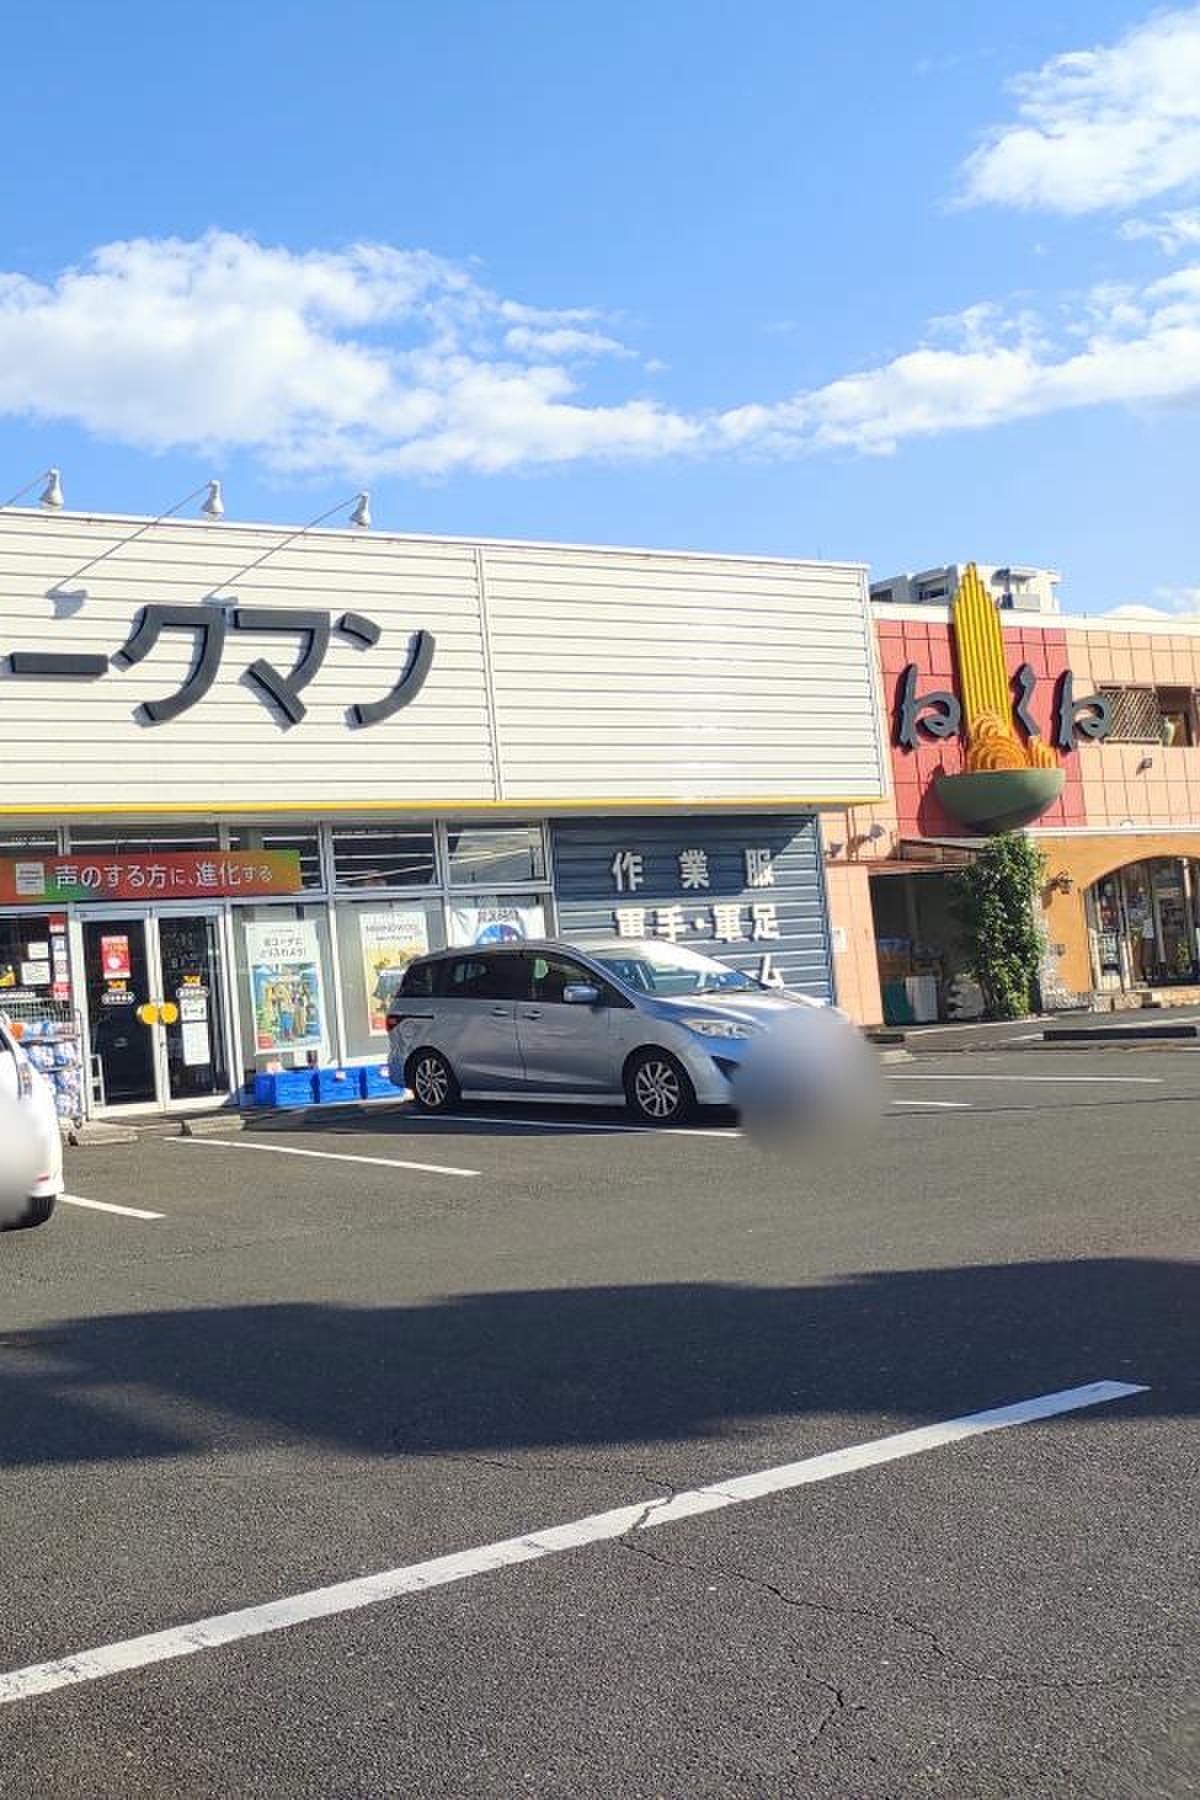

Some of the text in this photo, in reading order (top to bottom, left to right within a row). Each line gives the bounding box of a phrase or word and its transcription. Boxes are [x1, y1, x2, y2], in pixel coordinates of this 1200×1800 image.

[54, 862, 274, 891] 声のする方に、進化する
[612, 849, 775, 892] 作業服
